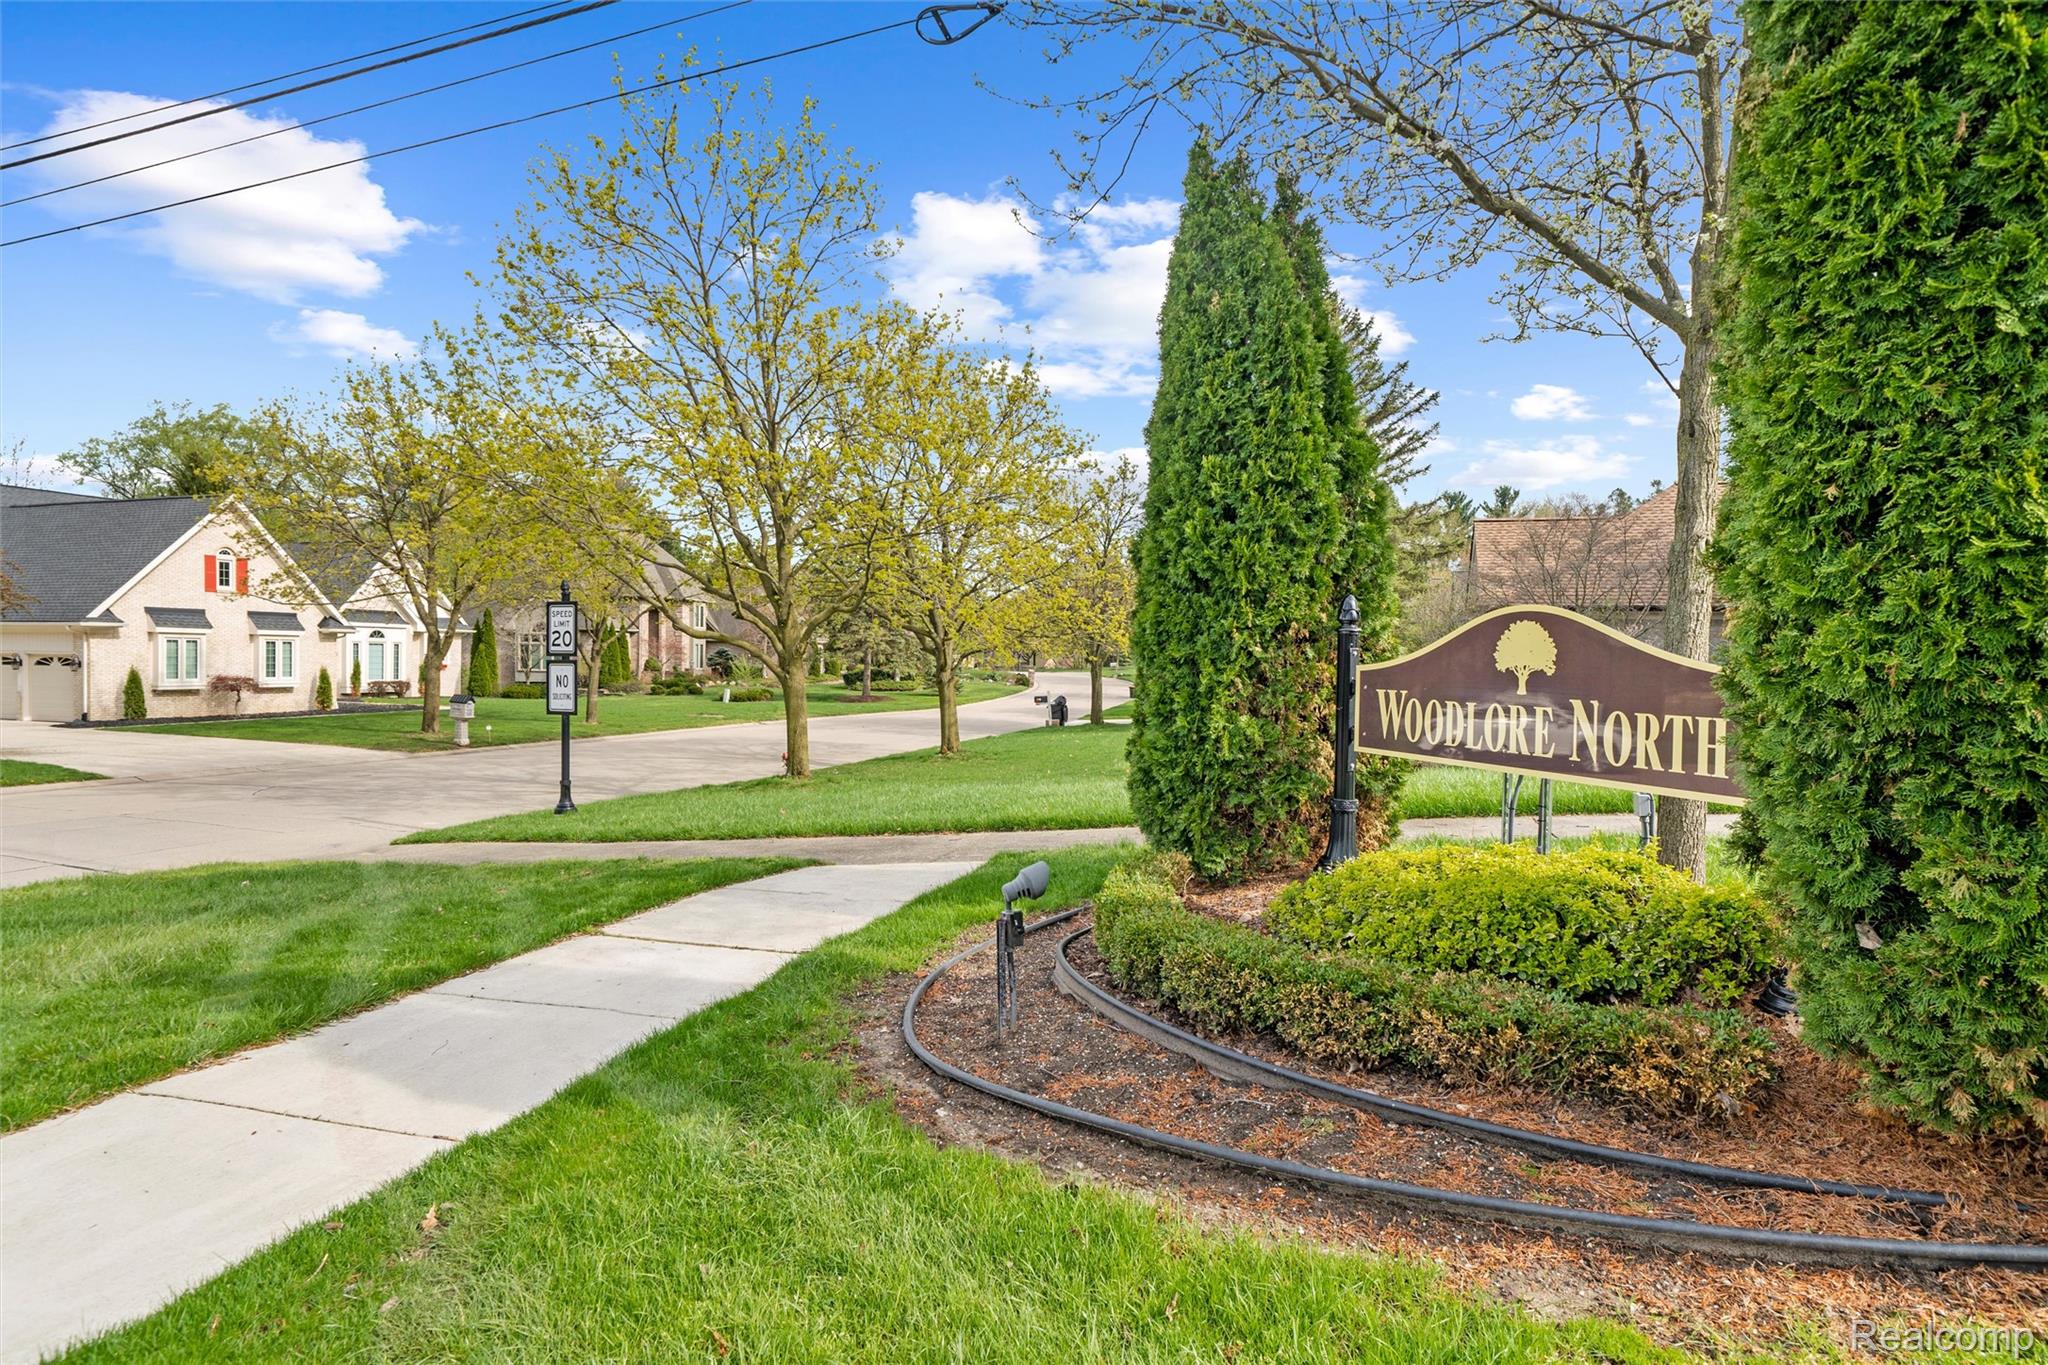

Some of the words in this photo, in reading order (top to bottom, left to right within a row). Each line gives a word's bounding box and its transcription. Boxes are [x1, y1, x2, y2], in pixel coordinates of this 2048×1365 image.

[551, 610, 573, 618] SPEED
[553, 620, 571, 628] LIMIT
[551, 630, 573, 647] 20
[555, 674, 569, 688] NO
[1376, 688, 1555, 758] WOODLORE
[1568, 699, 1729, 779] NORTH
